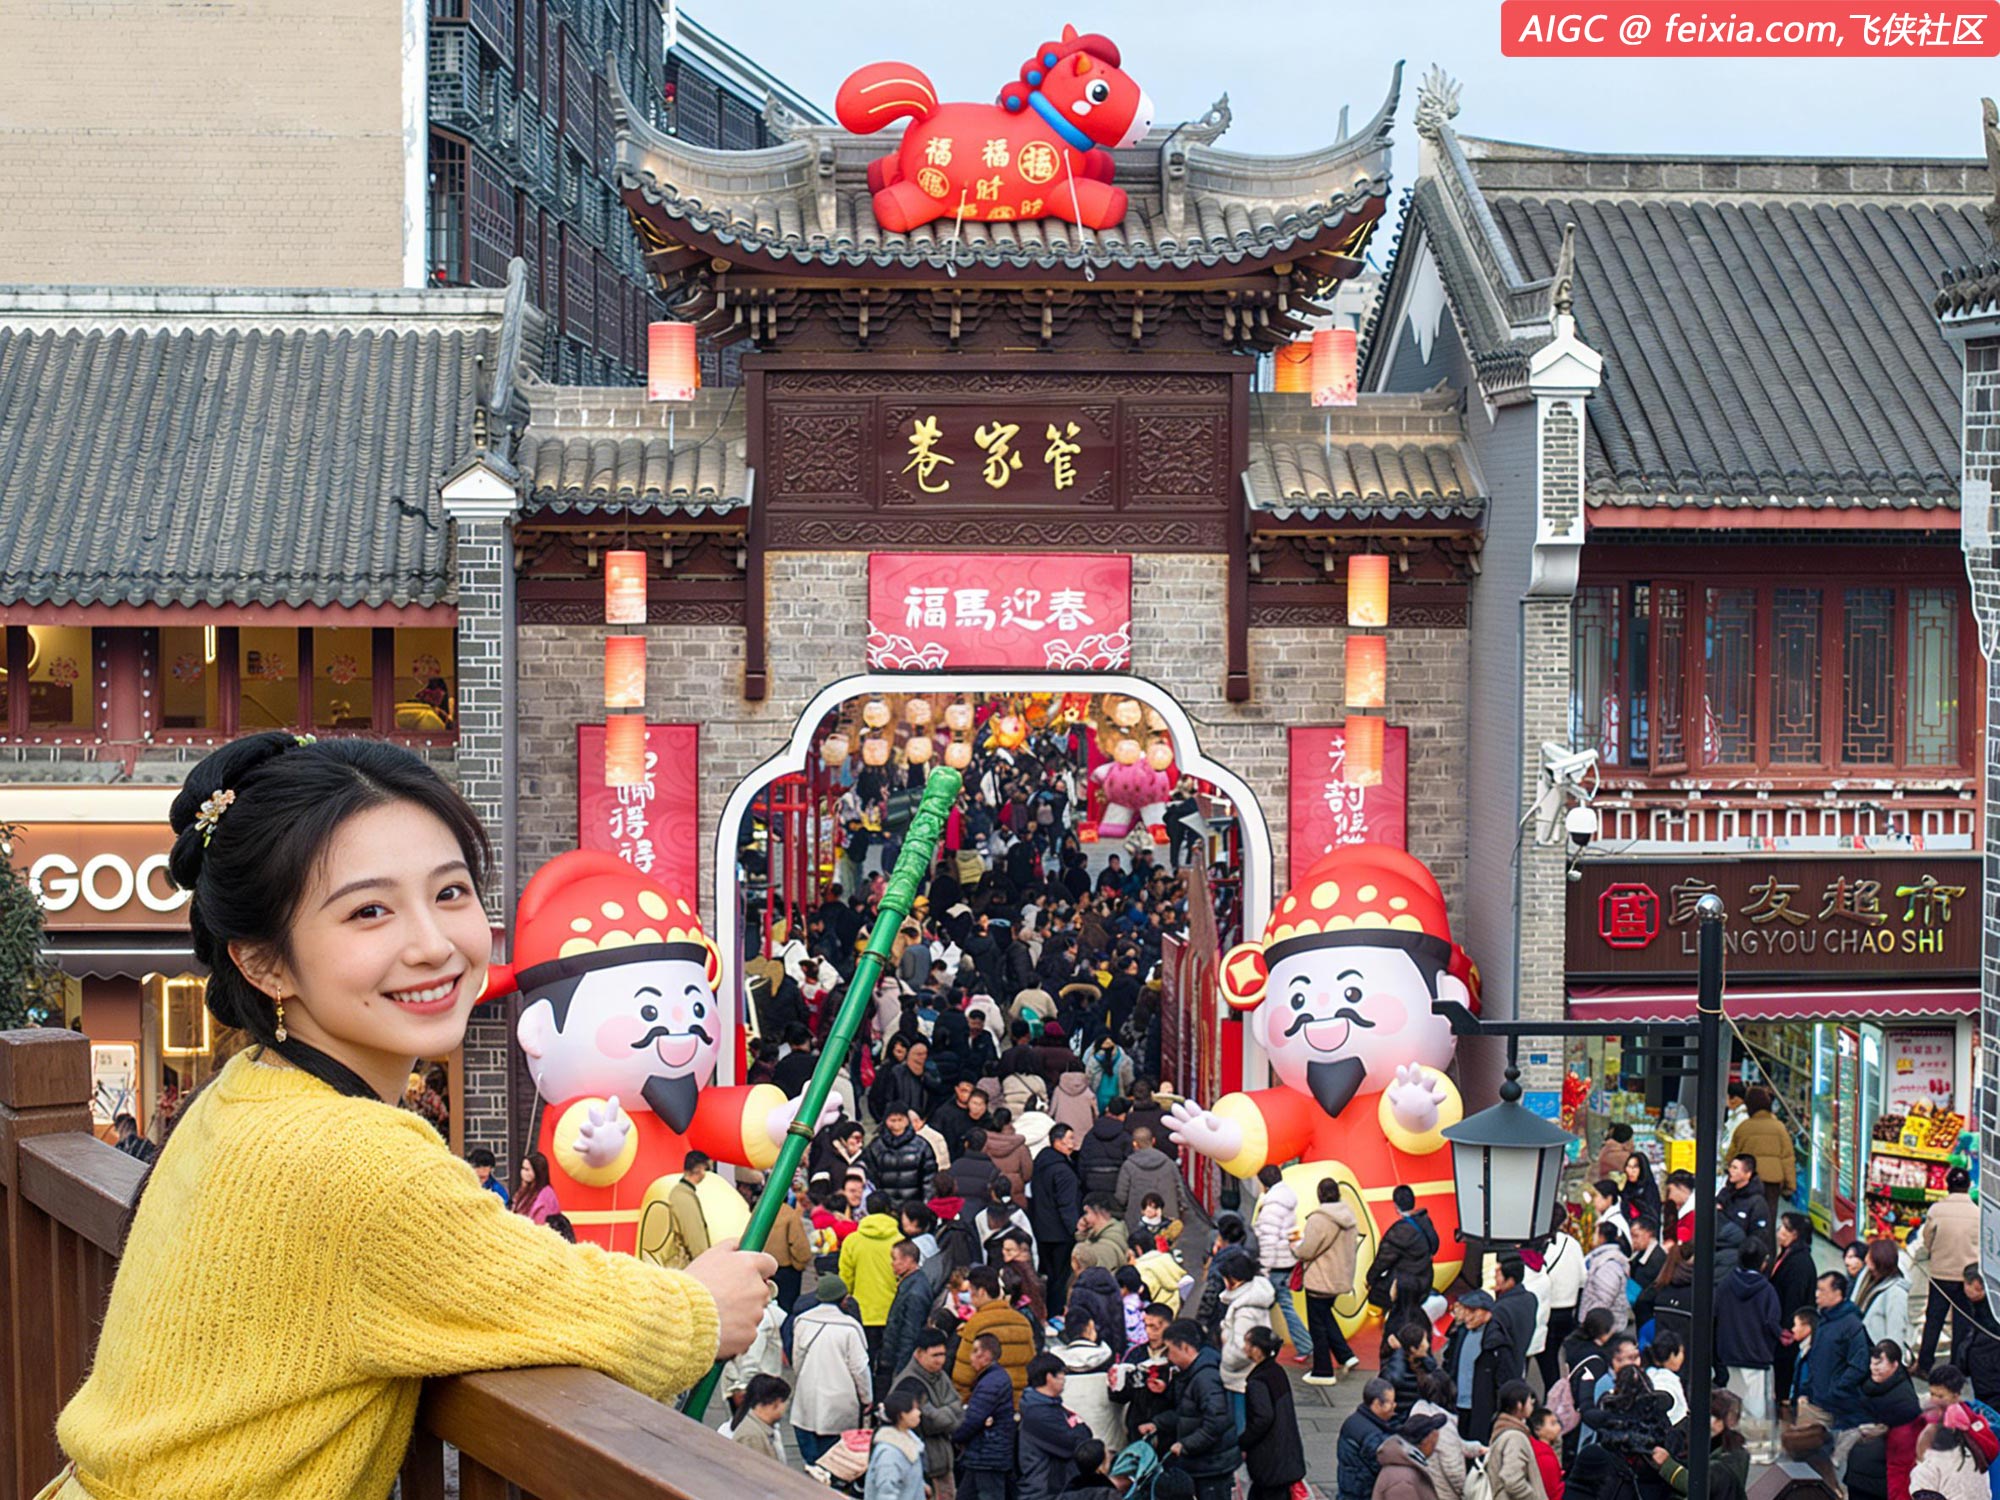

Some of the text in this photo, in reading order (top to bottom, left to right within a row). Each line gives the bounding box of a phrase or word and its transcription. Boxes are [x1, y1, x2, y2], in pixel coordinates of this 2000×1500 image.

[925, 136, 1053, 178] 福 福 福
[903, 586, 1095, 632] 福馬迎春
[1823, 929, 1896, 954] CHAO
[1901, 928, 1944, 954] SHI
